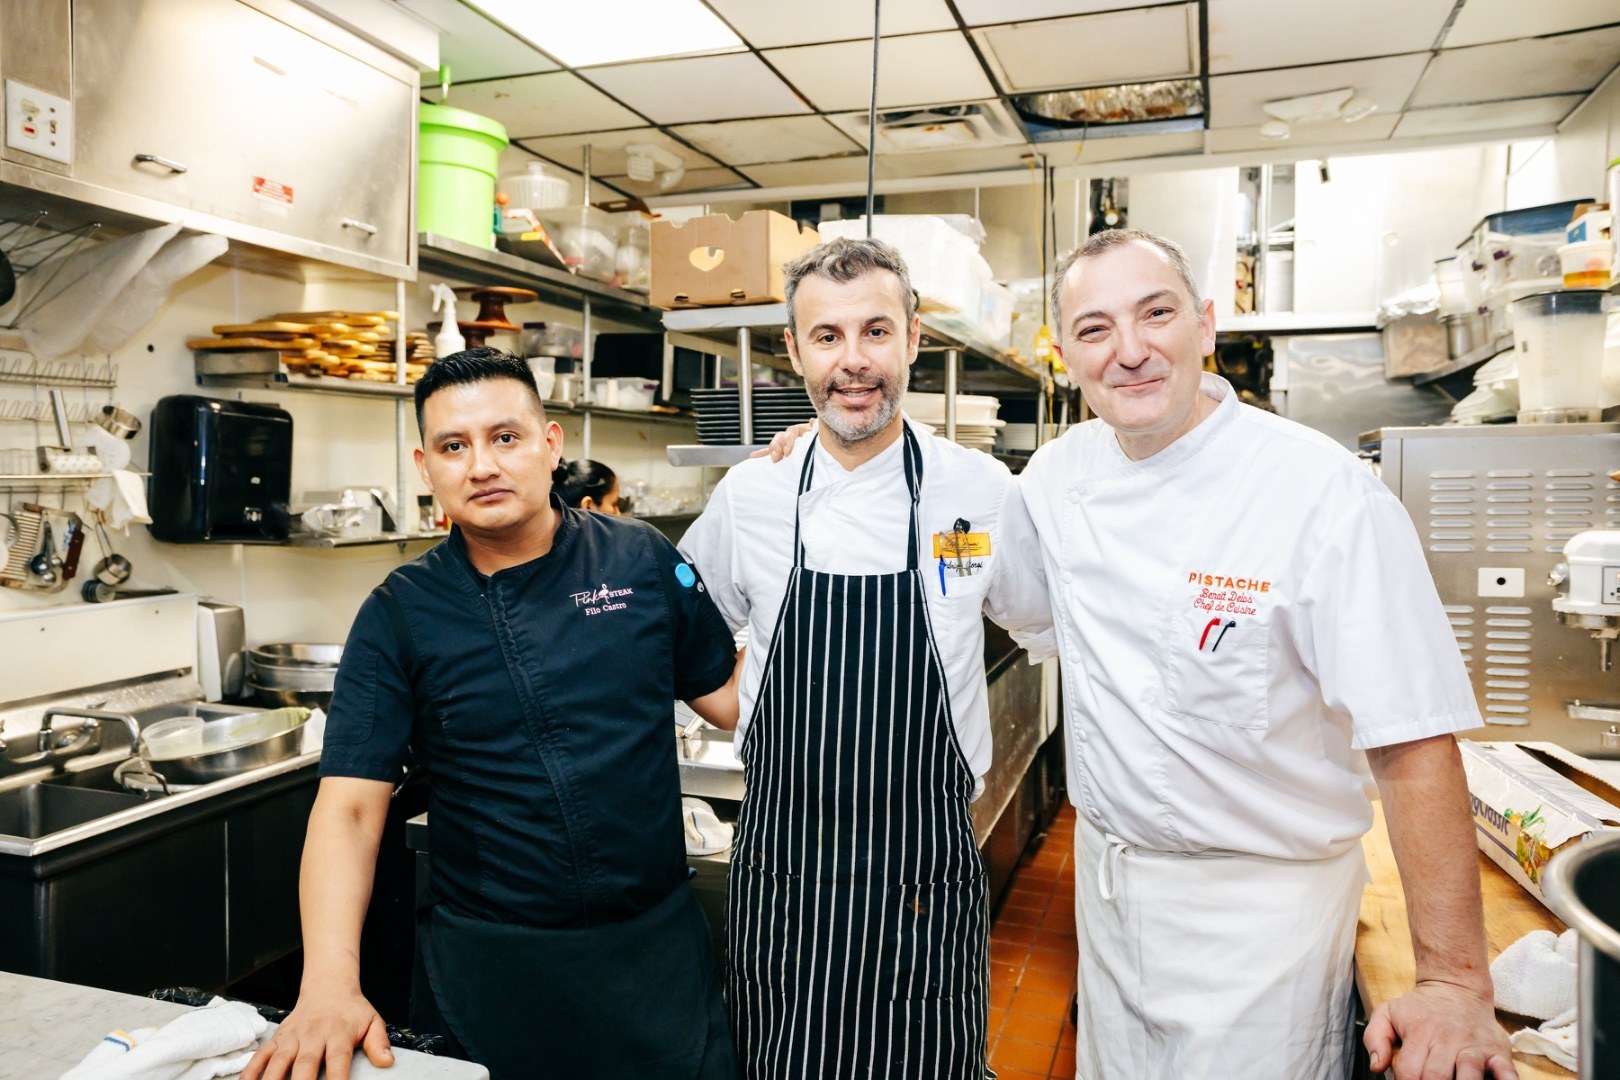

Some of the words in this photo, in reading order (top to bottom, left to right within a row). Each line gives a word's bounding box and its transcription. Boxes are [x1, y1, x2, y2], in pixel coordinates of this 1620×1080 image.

[1188, 572, 1271, 593] PISTACHE
[609, 588, 634, 598] STEAK
[602, 603, 627, 612] Castro
[1193, 598, 1214, 614] Chef
[1215, 602, 1225, 611] de
[1227, 602, 1257, 616] Cuisine
